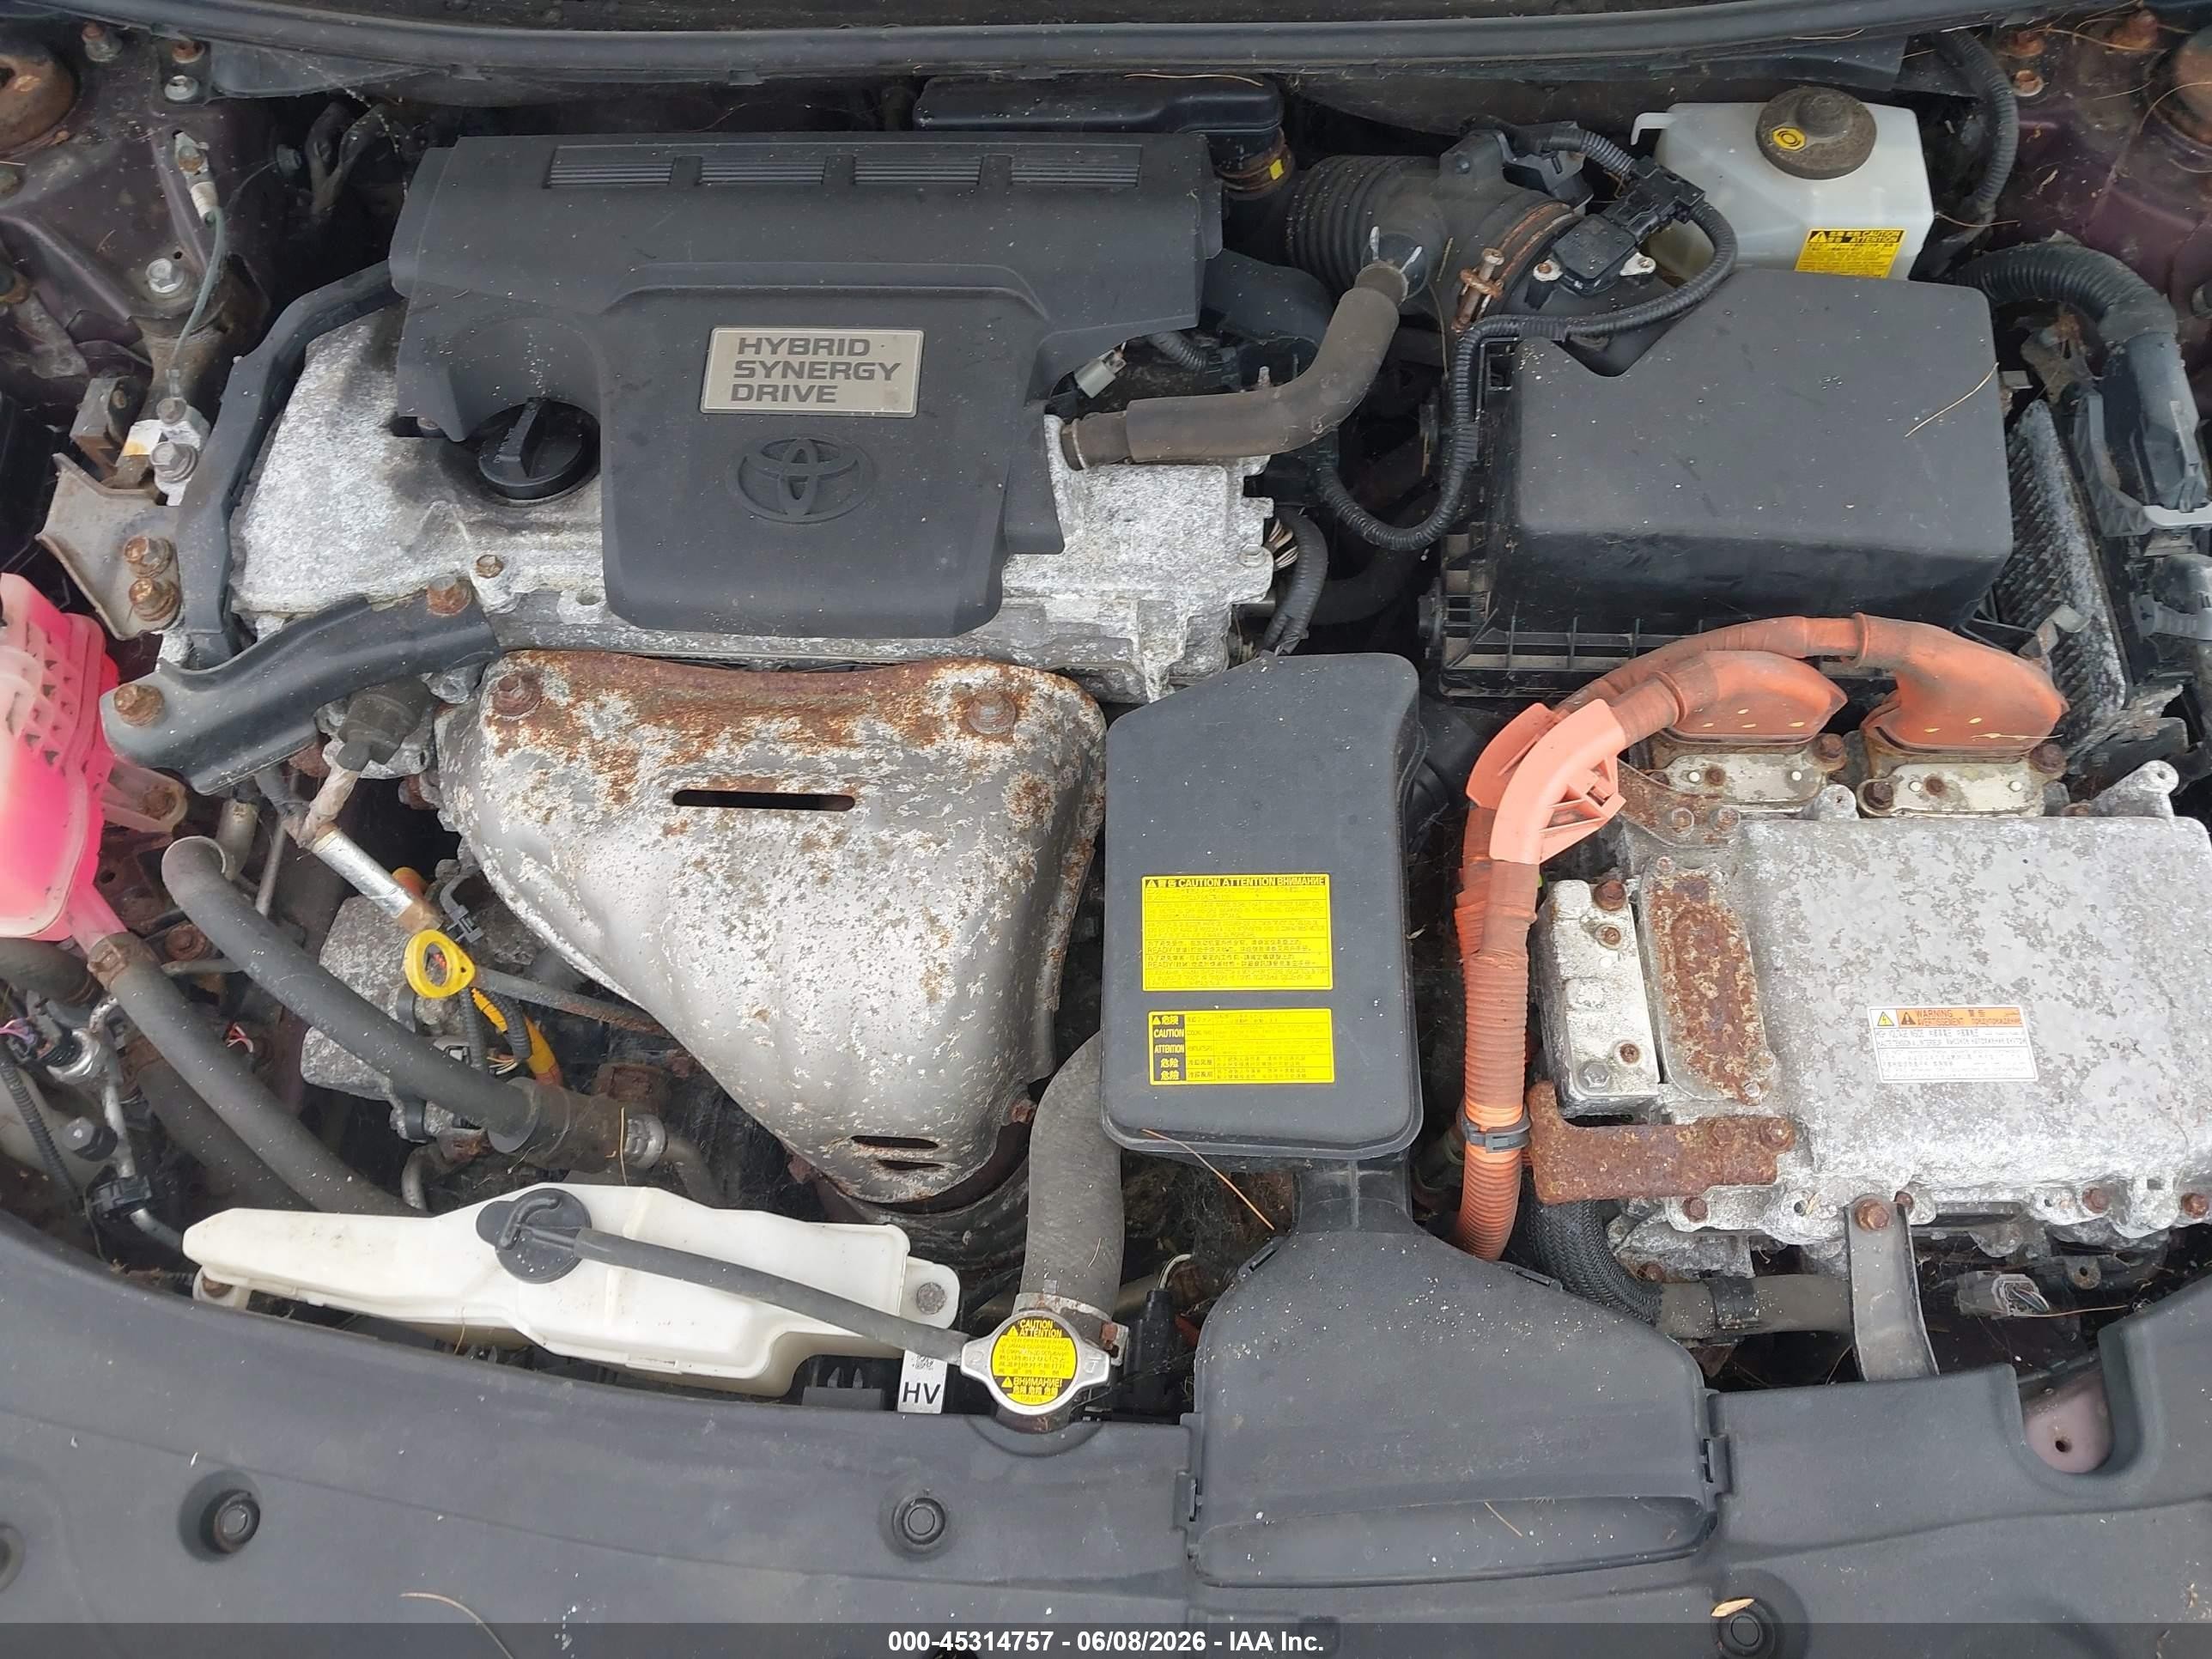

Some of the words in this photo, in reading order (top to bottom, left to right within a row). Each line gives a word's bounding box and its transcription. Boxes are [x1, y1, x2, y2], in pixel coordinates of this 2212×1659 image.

[738, 337, 871, 356] HYBRID
[733, 360, 901, 381] SYNERGY
[731, 384, 838, 404] DRIVE
[1178, 878, 1220, 887] CAUTION
[1222, 878, 1276, 887] ATTENTION
[1277, 877, 1325, 886] ВНИМАНИЕ
[1916, 1009, 1953, 1018] WARNING
[1153, 1028, 1184, 1038] CAUTION
[1154, 1044, 1184, 1054] ATTENTION
[1019, 1319, 1053, 1329] CAUTION
[1019, 1328, 1062, 1338] ATTENTION
[1013, 1376, 1062, 1388] ВНИМАНИЕ!
[902, 1382, 941, 1404] HV
